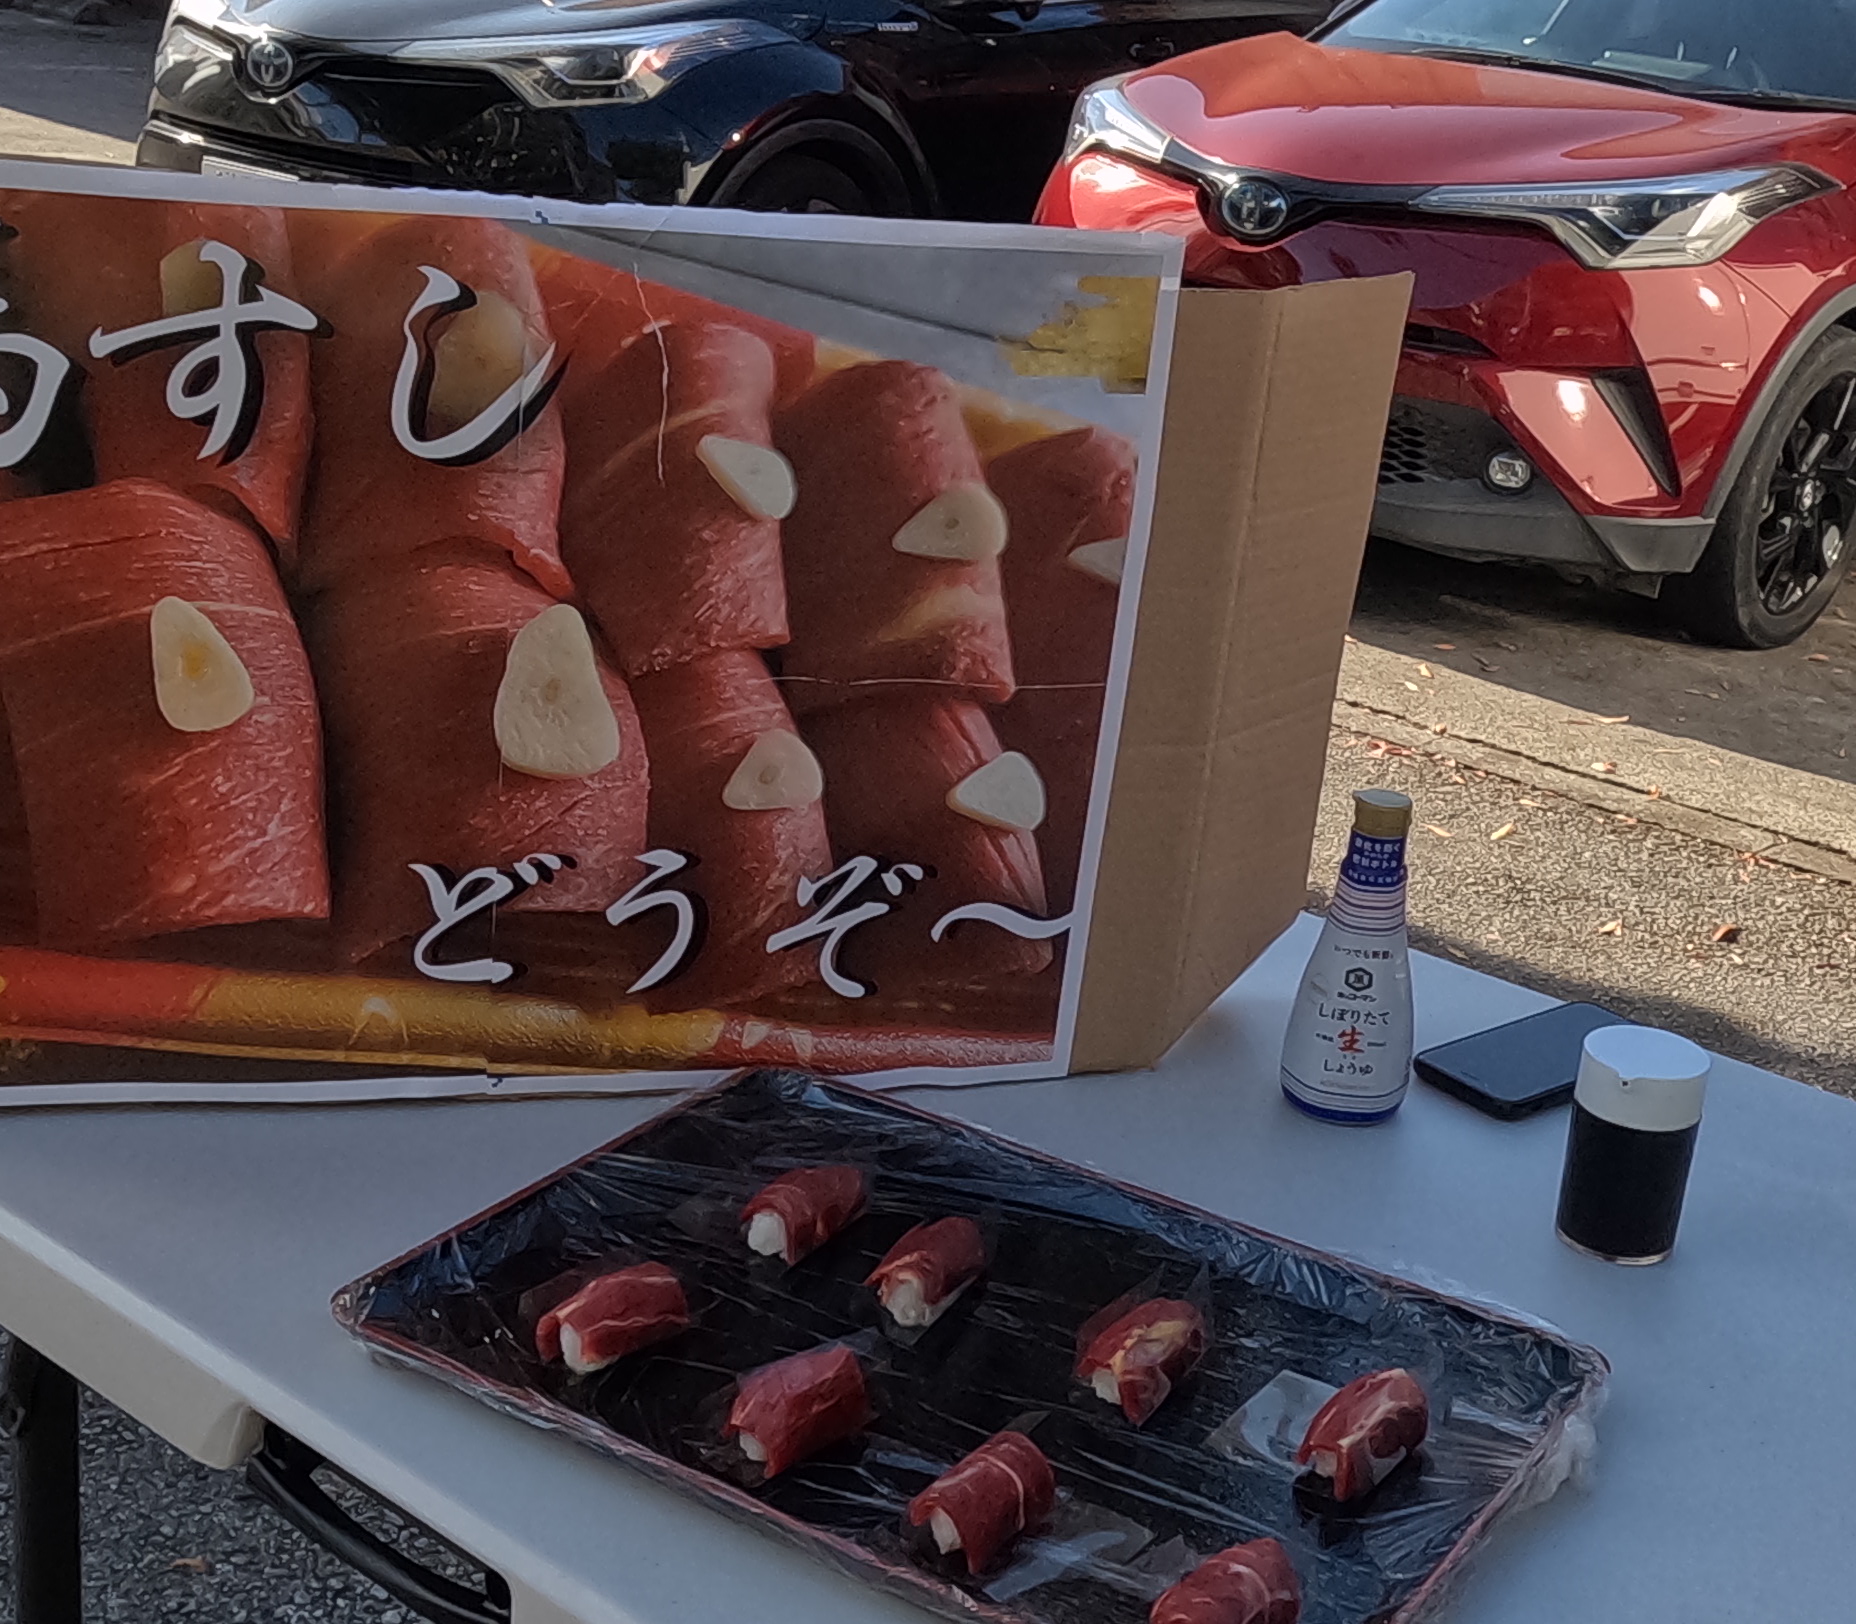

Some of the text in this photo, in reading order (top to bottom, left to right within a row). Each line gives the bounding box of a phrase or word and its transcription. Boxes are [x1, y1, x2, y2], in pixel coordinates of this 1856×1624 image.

[1319, 1003, 1390, 1025] しぼりたて
[1337, 1025, 1365, 1053] 生
[1324, 1059, 1373, 1076] しょうゆ
